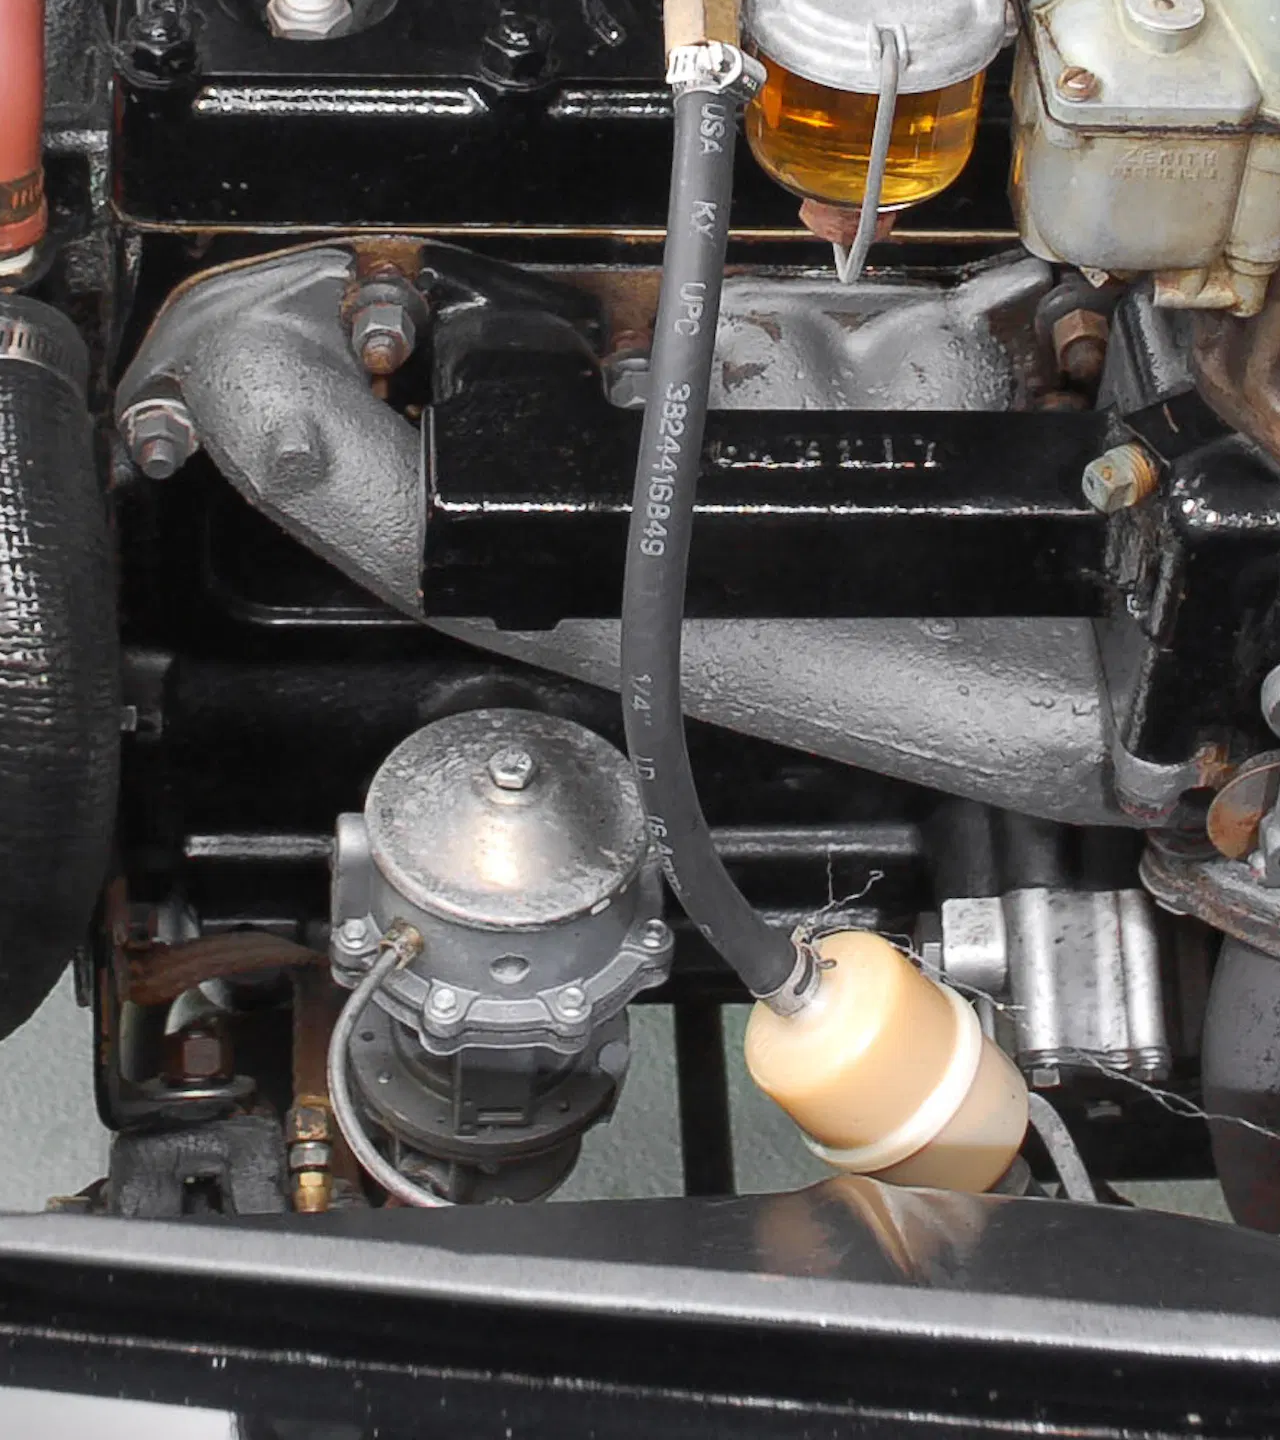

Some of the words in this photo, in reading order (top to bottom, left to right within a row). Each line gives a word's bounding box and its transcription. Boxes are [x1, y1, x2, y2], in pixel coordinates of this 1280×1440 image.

[700, 102, 726, 155] USA
[1121, 145, 1219, 167] ZENITH
[674, 281, 706, 336] UPC
